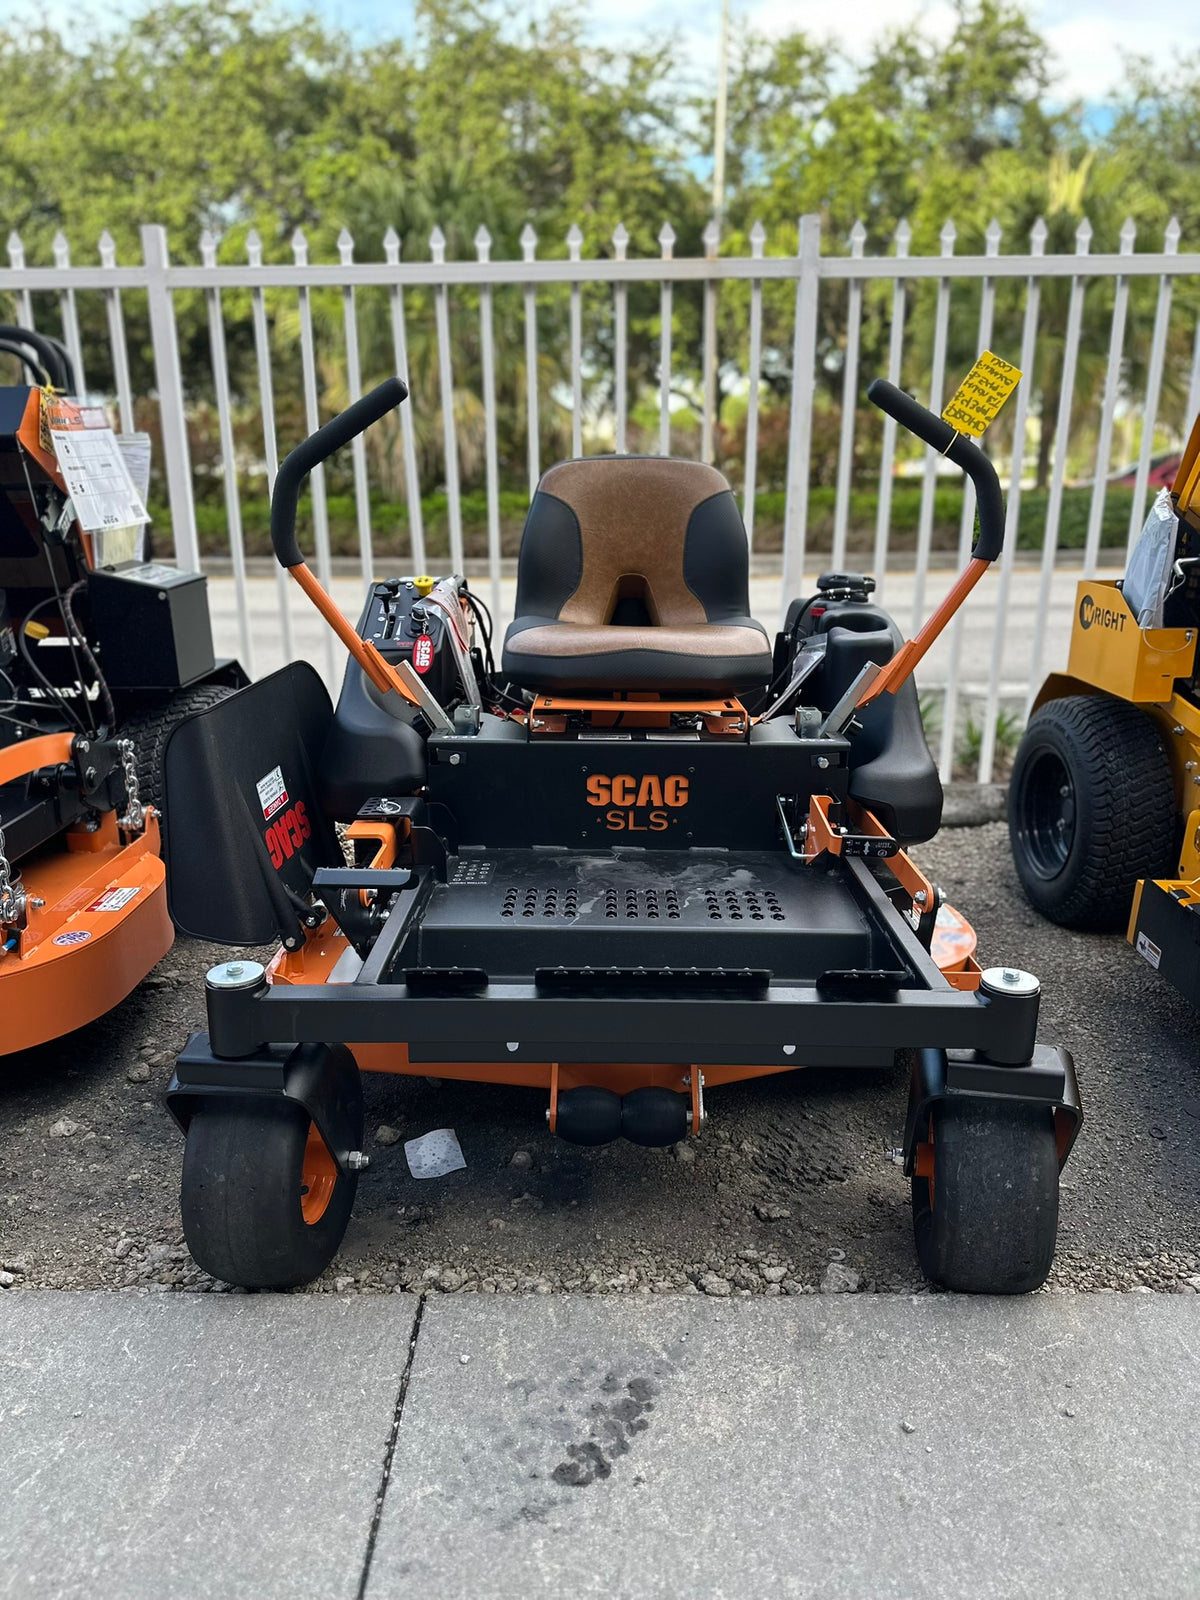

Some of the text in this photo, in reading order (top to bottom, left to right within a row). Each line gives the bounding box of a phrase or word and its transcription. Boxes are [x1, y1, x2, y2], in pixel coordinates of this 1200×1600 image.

[1080, 595, 1127, 632] WRIGHT
[419, 640, 431, 667] SCAG
[586, 774, 689, 807] SCAG
[265, 800, 311, 870] SCAG
[606, 810, 669, 831] SLS
